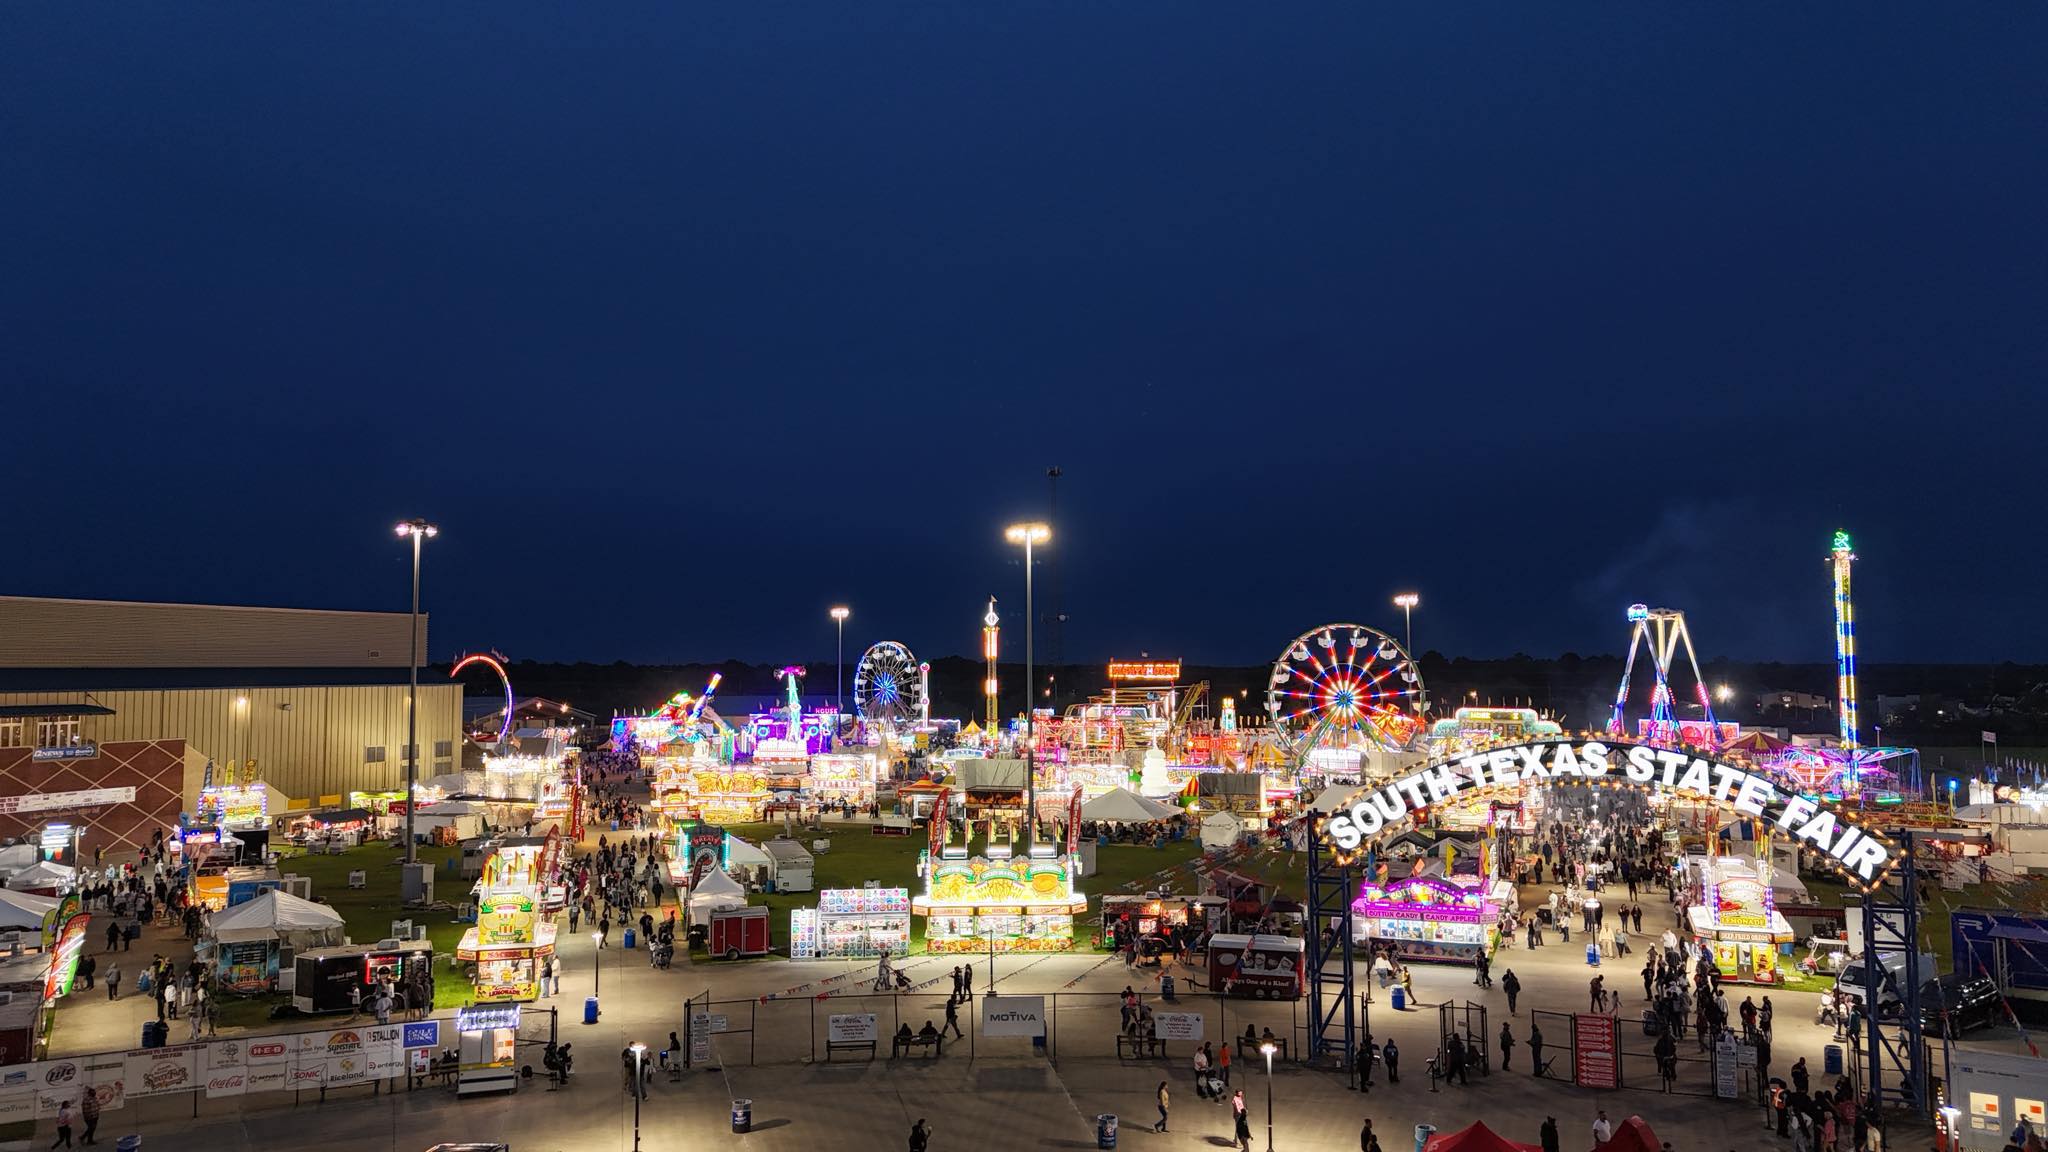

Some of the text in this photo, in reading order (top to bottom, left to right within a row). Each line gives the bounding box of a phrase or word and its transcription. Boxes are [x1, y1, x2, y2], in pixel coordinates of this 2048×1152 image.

[1330, 742, 1887, 881] SOUTH TEXAS STATE FAIR
[990, 1011, 1036, 1022] MOTIVA
[372, 1029, 400, 1041] STALLION
[293, 1070, 320, 1079] SONIC
